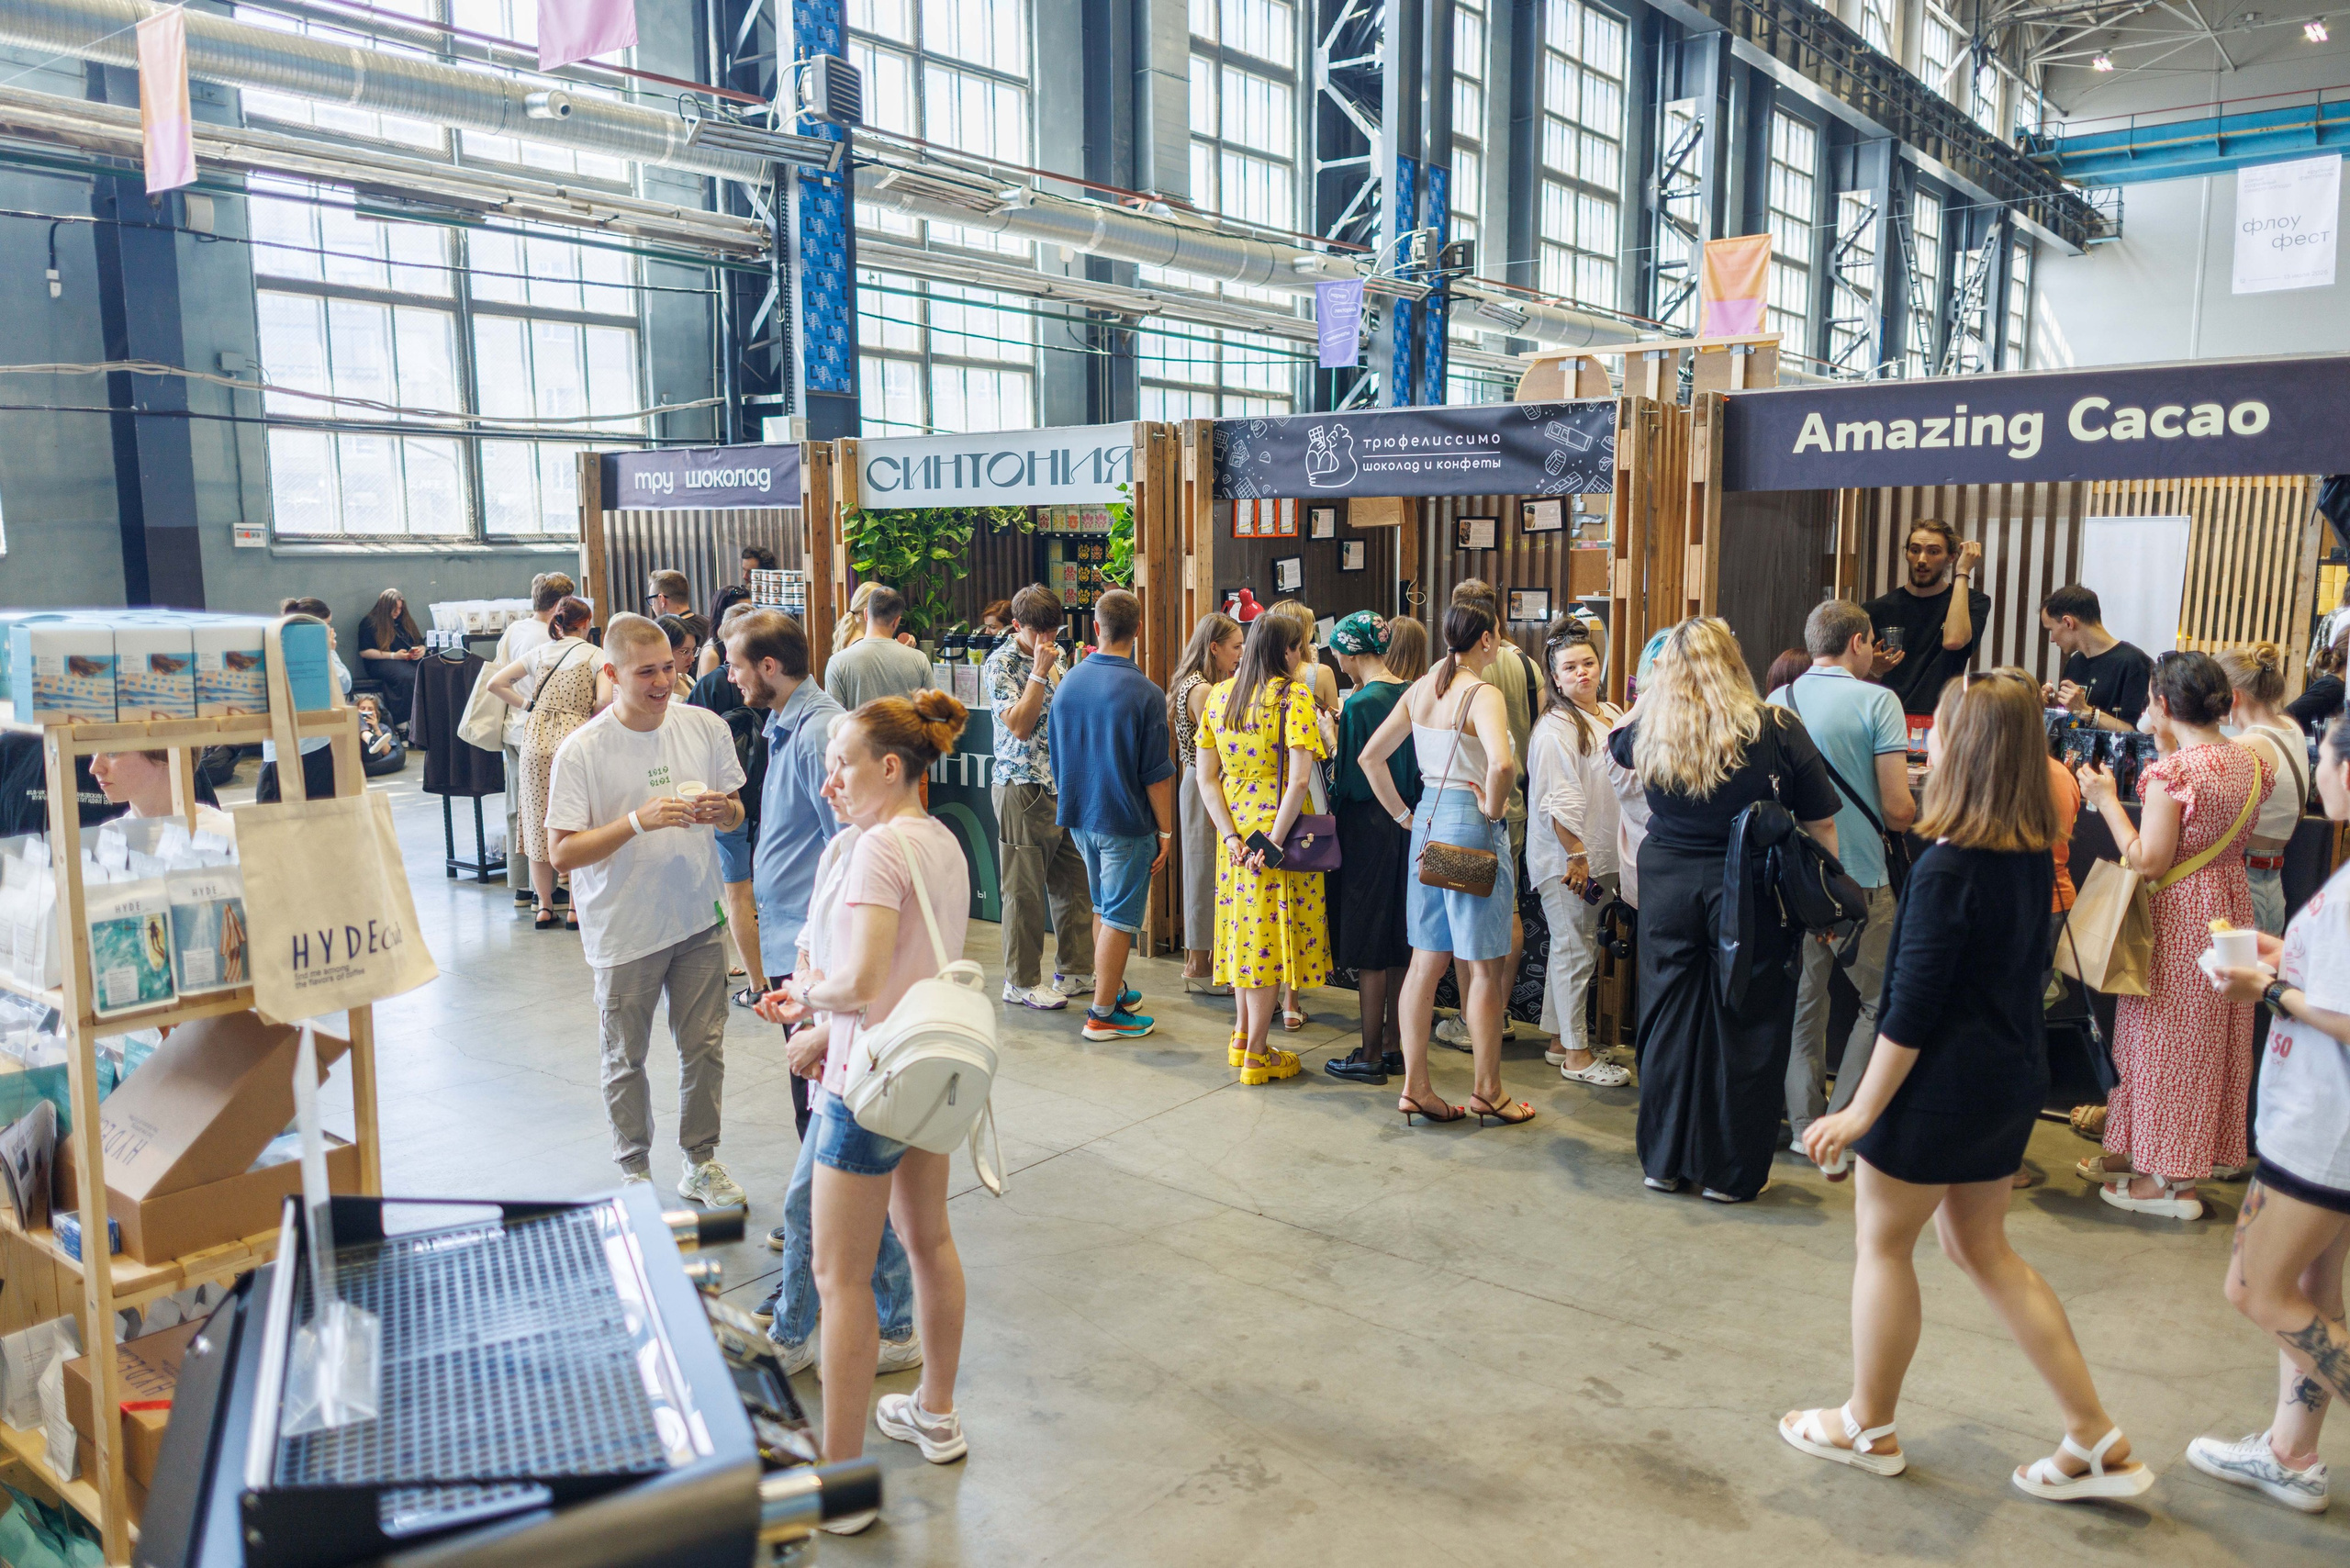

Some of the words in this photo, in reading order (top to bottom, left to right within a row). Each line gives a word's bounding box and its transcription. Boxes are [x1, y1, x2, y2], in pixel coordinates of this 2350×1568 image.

[2243, 215, 2301, 236] флоу
[2272, 230, 2330, 252] фест
[1792, 404, 2044, 459] Amazing
[2067, 397, 2271, 442] Cacao
[1363, 433, 1501, 451] трюфелиссимо
[867, 445, 1134, 492] СИНТОНИЯ
[1362, 461, 1420, 474] шоколад
[1424, 461, 1432, 470] и
[1437, 456, 1501, 472] конфеты
[634, 471, 674, 495] тру
[685, 467, 771, 493] шоколад
[648, 766, 668, 777] 1010
[650, 776, 670, 787] 0101
[192, 886, 218, 897] HYDE
[115, 901, 140, 913] HYDE
[293, 919, 378, 970] HYDE
